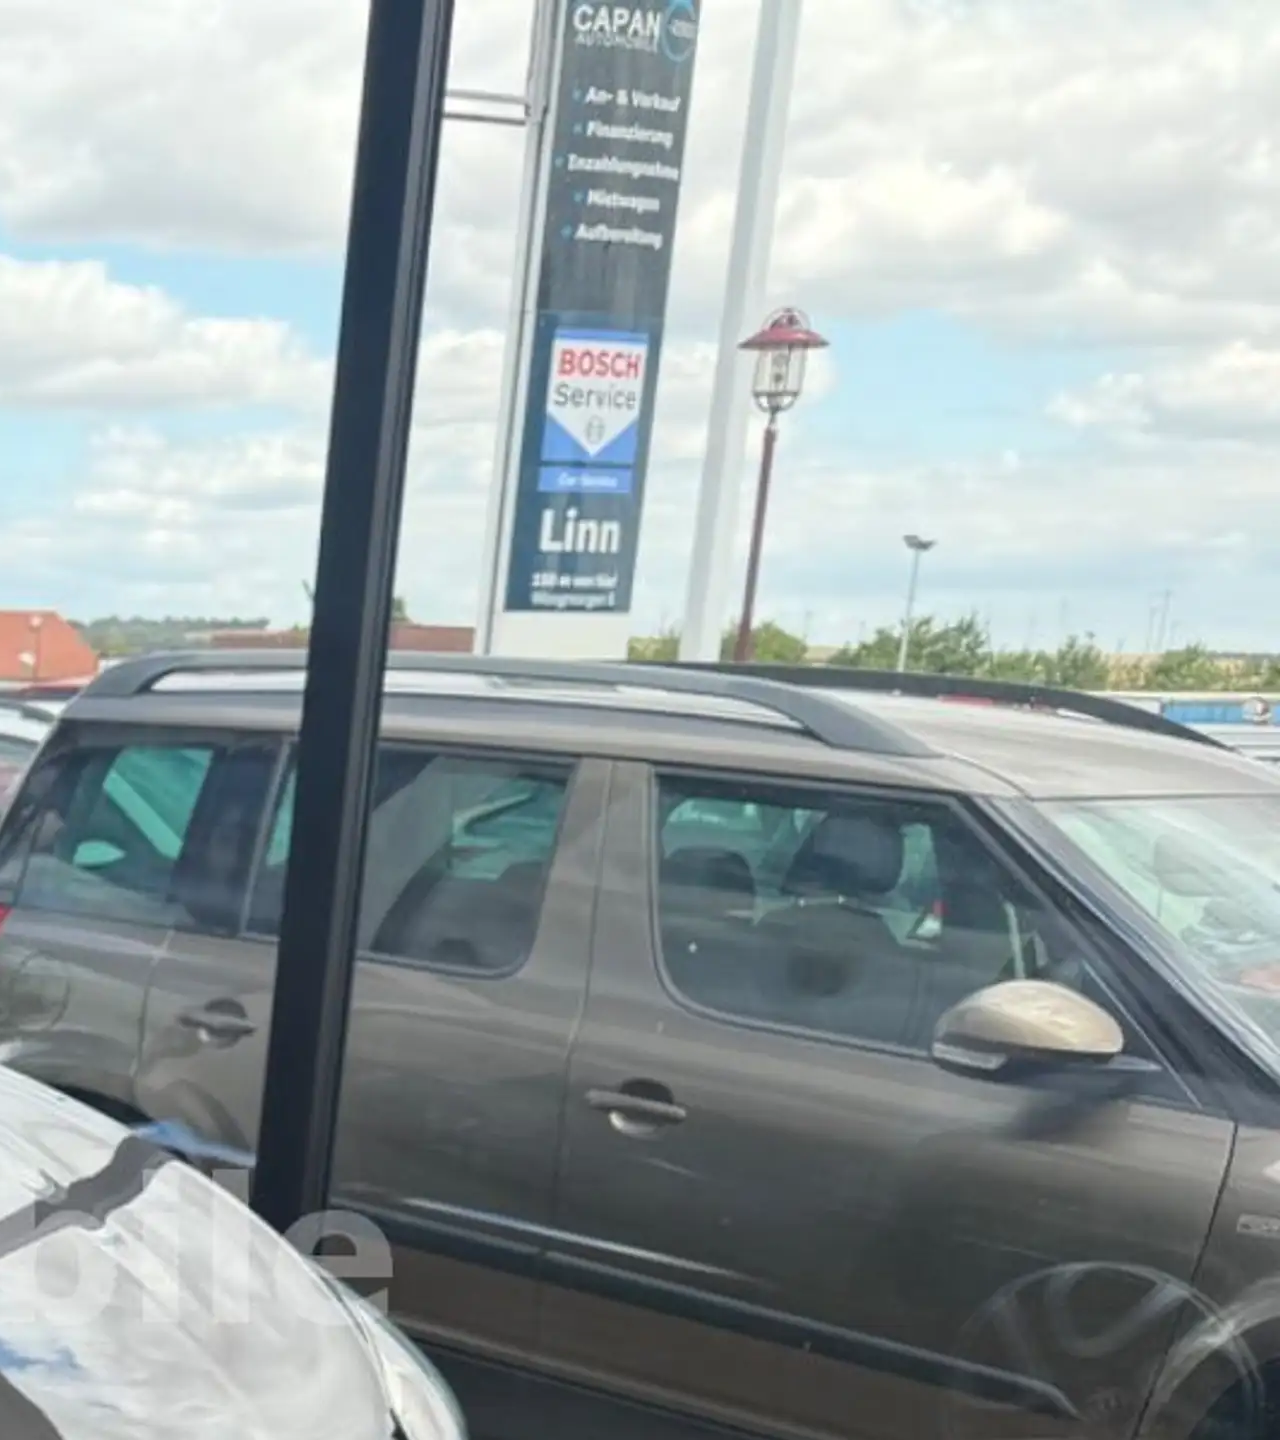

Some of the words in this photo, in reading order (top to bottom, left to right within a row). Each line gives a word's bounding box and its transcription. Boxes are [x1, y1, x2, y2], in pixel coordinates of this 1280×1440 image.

[573, 4, 661, 38] CAPAN
[558, 348, 642, 379] BOSCH
[553, 381, 637, 411] Service
[540, 507, 620, 554] Linn
